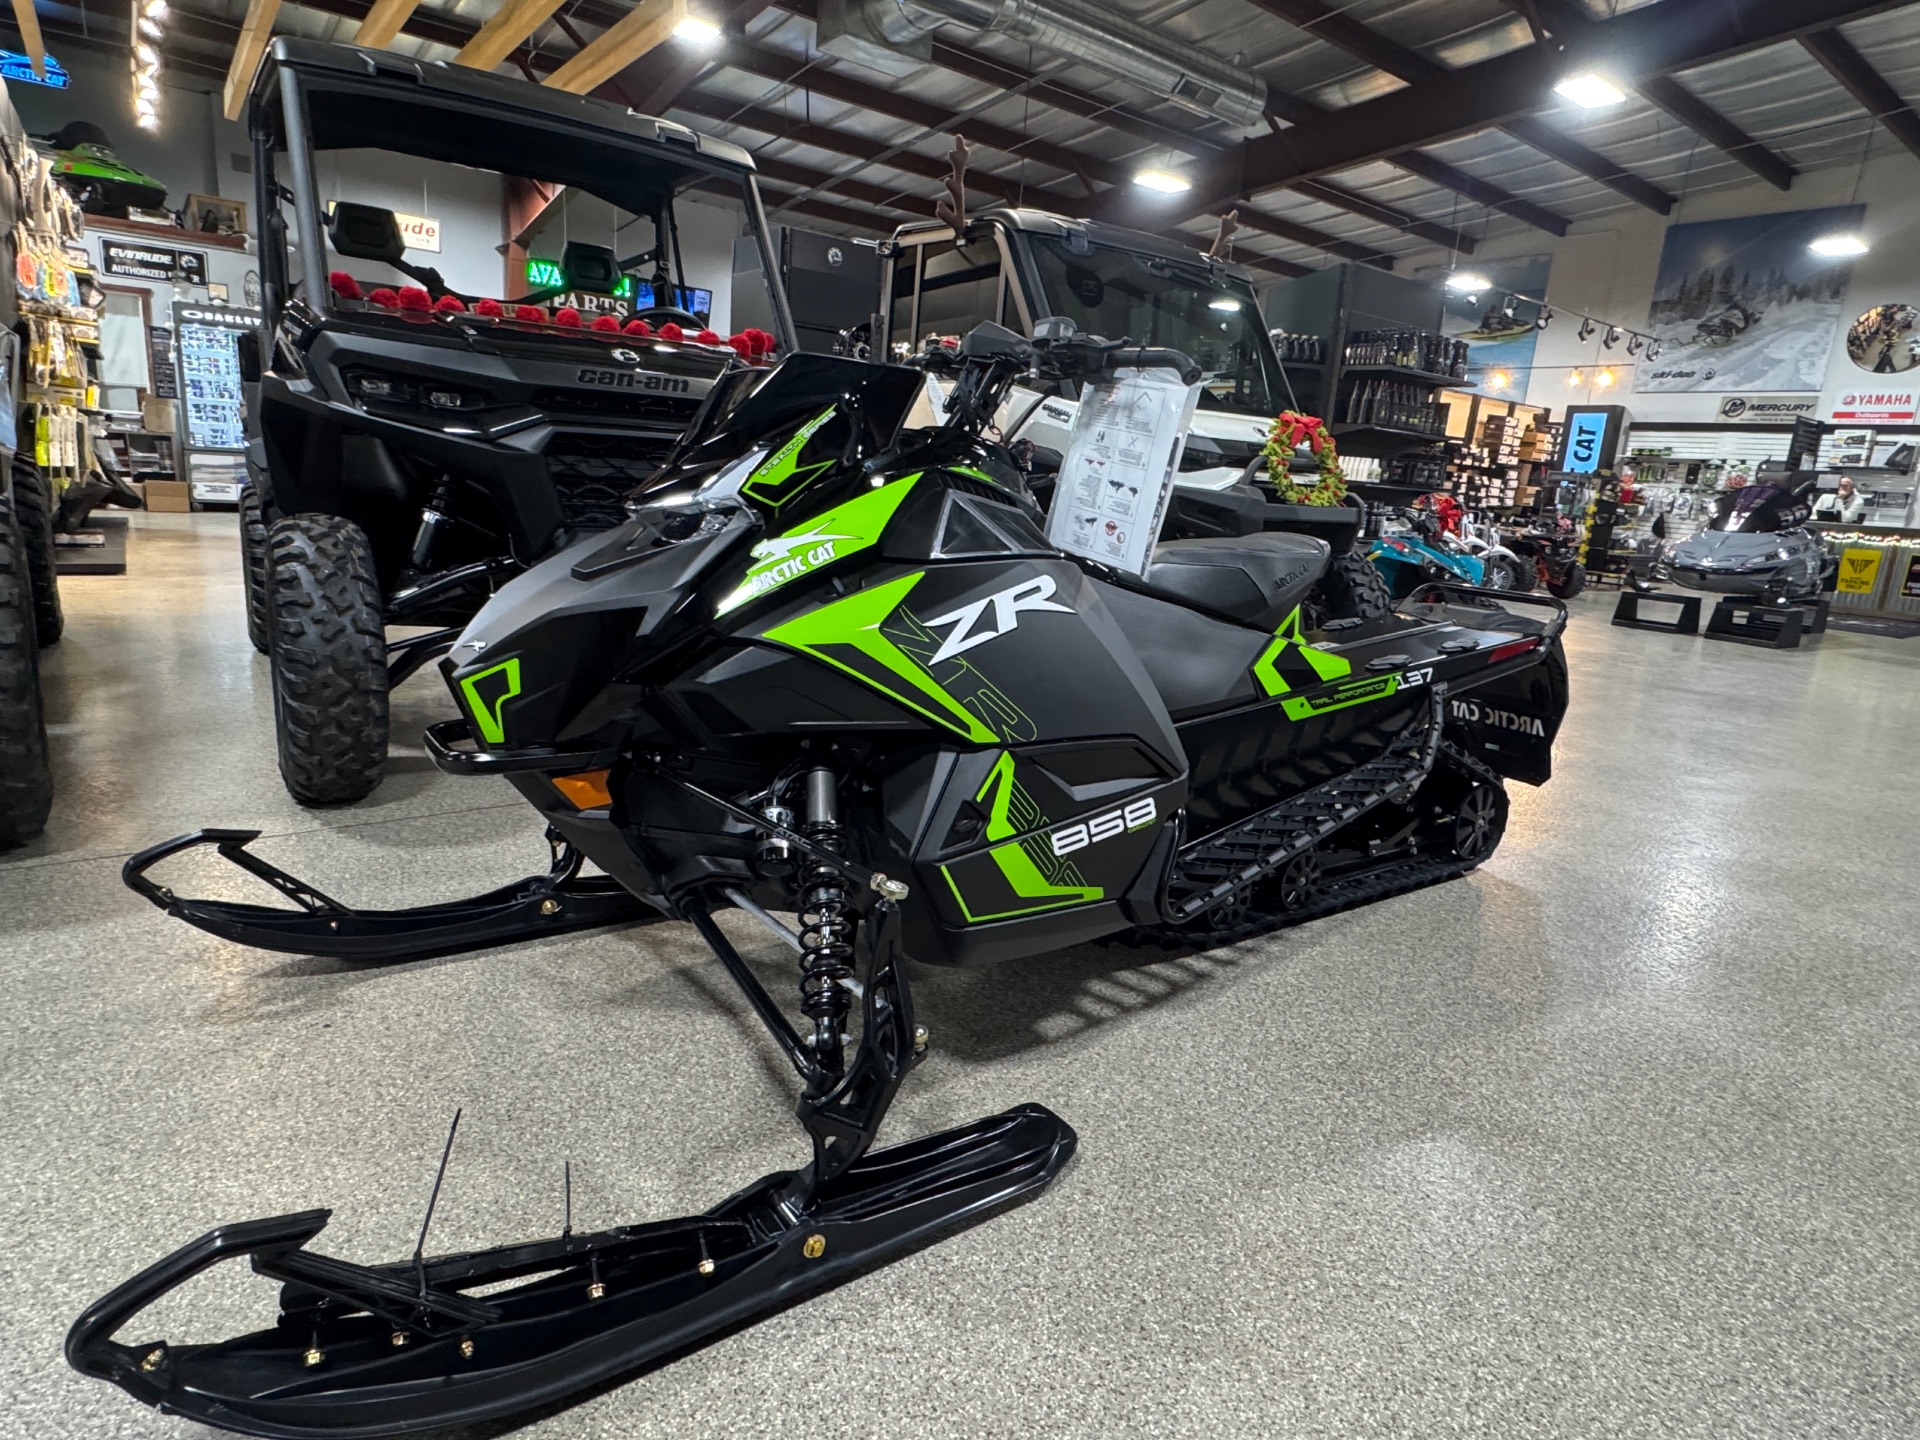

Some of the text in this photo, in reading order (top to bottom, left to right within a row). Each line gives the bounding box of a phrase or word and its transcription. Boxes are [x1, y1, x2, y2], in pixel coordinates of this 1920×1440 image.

[109, 247, 173, 265] EVINRUDE
[111, 263, 167, 279] AUTHORIZED
[552, 291, 628, 318] PARTS
[204, 312, 263, 326] OAKLEY
[578, 368, 689, 393] can-am
[1747, 403, 1816, 412] MERCURY
[1858, 394, 1912, 406] YAMAHA
[1572, 425, 1598, 463] CAT
[759, 437, 804, 477] STEALTH
[751, 541, 836, 594] ARCTIC CAT
[922, 574, 1079, 667] ZR
[1395, 667, 1433, 691] 137
[1050, 797, 1157, 857] 858
